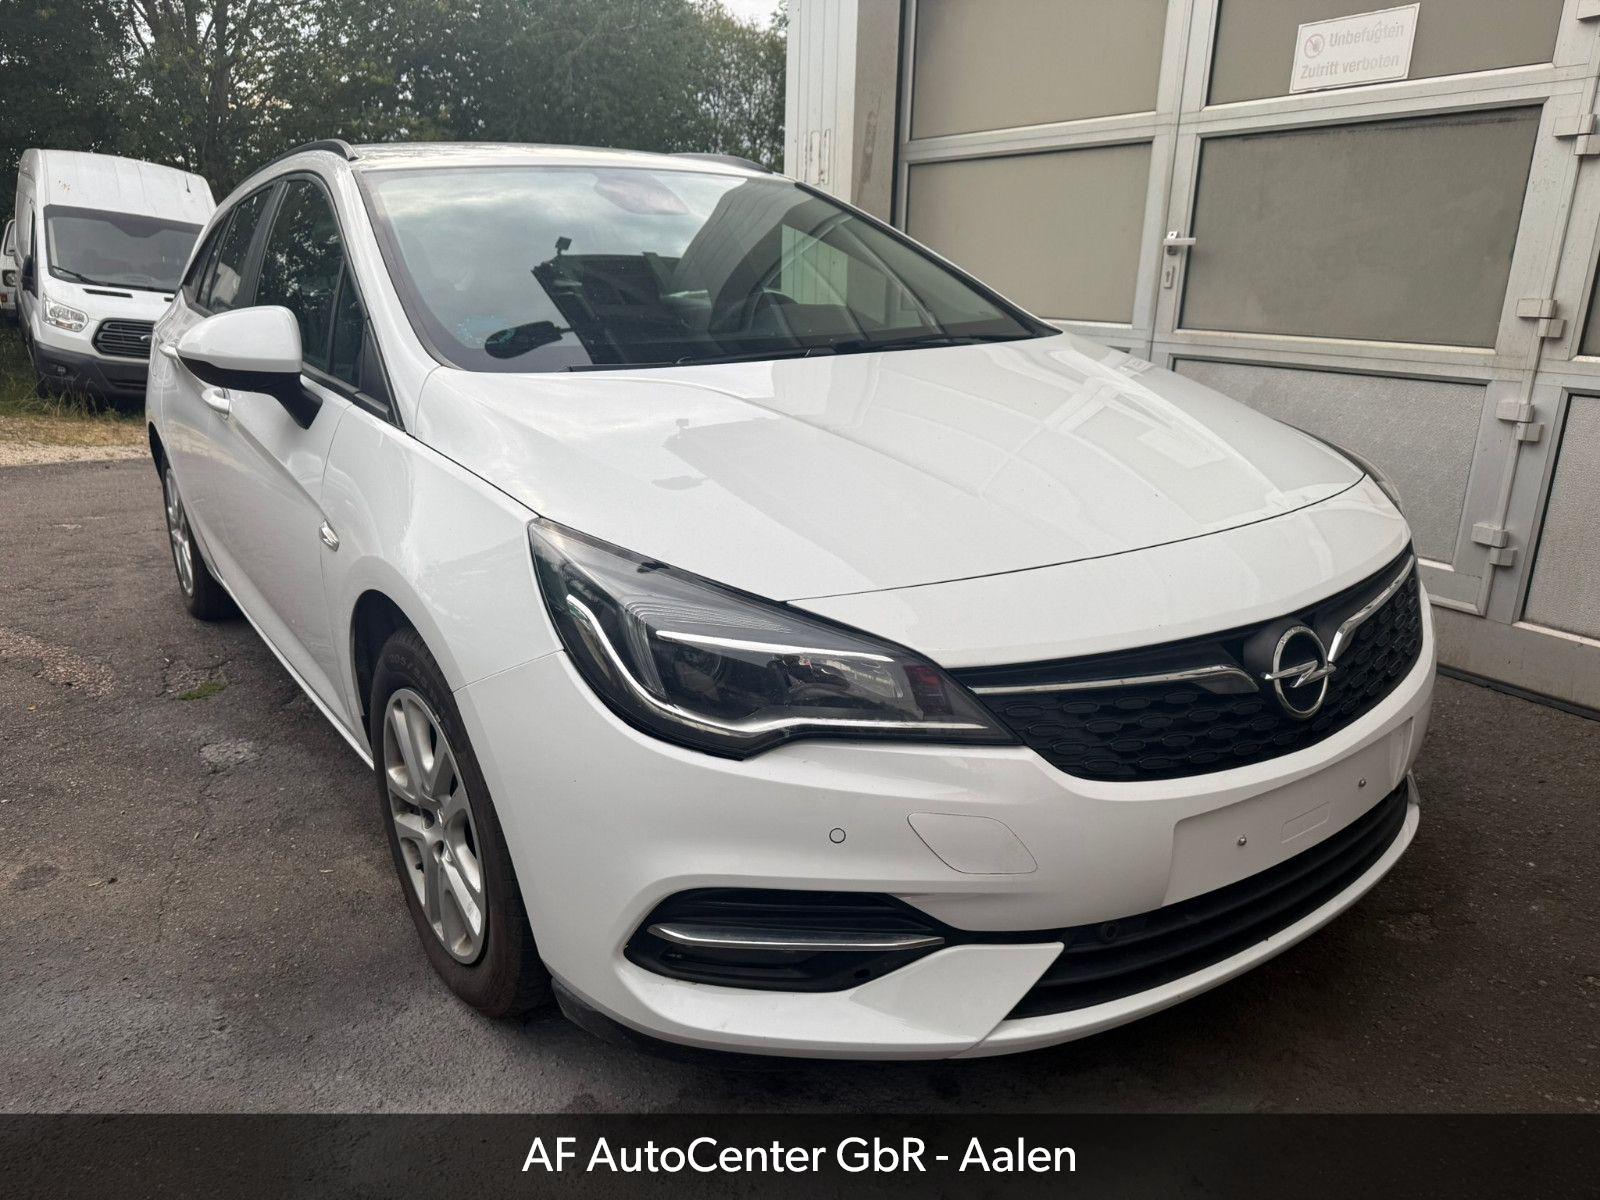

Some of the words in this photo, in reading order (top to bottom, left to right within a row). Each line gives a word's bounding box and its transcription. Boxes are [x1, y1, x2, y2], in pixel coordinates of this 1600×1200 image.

[1329, 24, 1404, 47] Unbefugten
[1300, 61, 1338, 80] Zutritt
[1342, 54, 1399, 74] verboten
